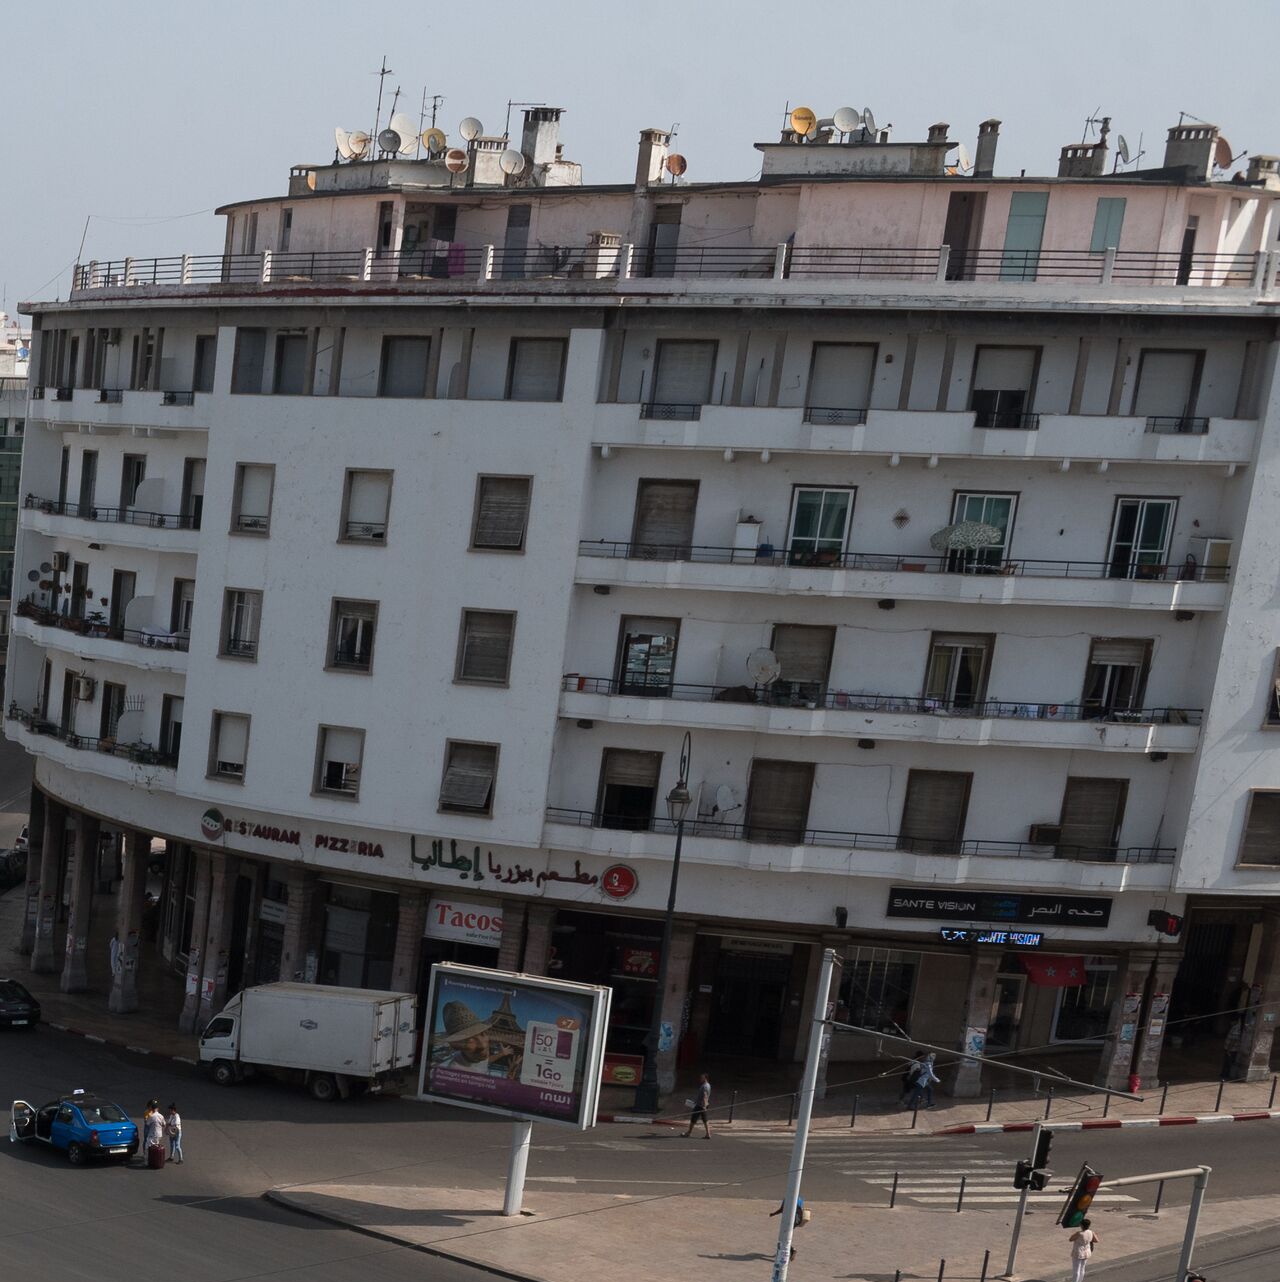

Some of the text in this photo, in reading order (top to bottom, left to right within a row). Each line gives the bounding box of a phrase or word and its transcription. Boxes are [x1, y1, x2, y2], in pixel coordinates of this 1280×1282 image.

[536, 860, 599, 888] مطعم
[894, 899, 934, 909] SANTE
[938, 901, 976, 911] VISION
[435, 903, 504, 933] Tacos
[1009, 932, 1041, 946] VISION
[536, 1034, 553, 1047] 50
[536, 1063, 561, 1081] 1Go
[540, 1091, 571, 1105] inwi
